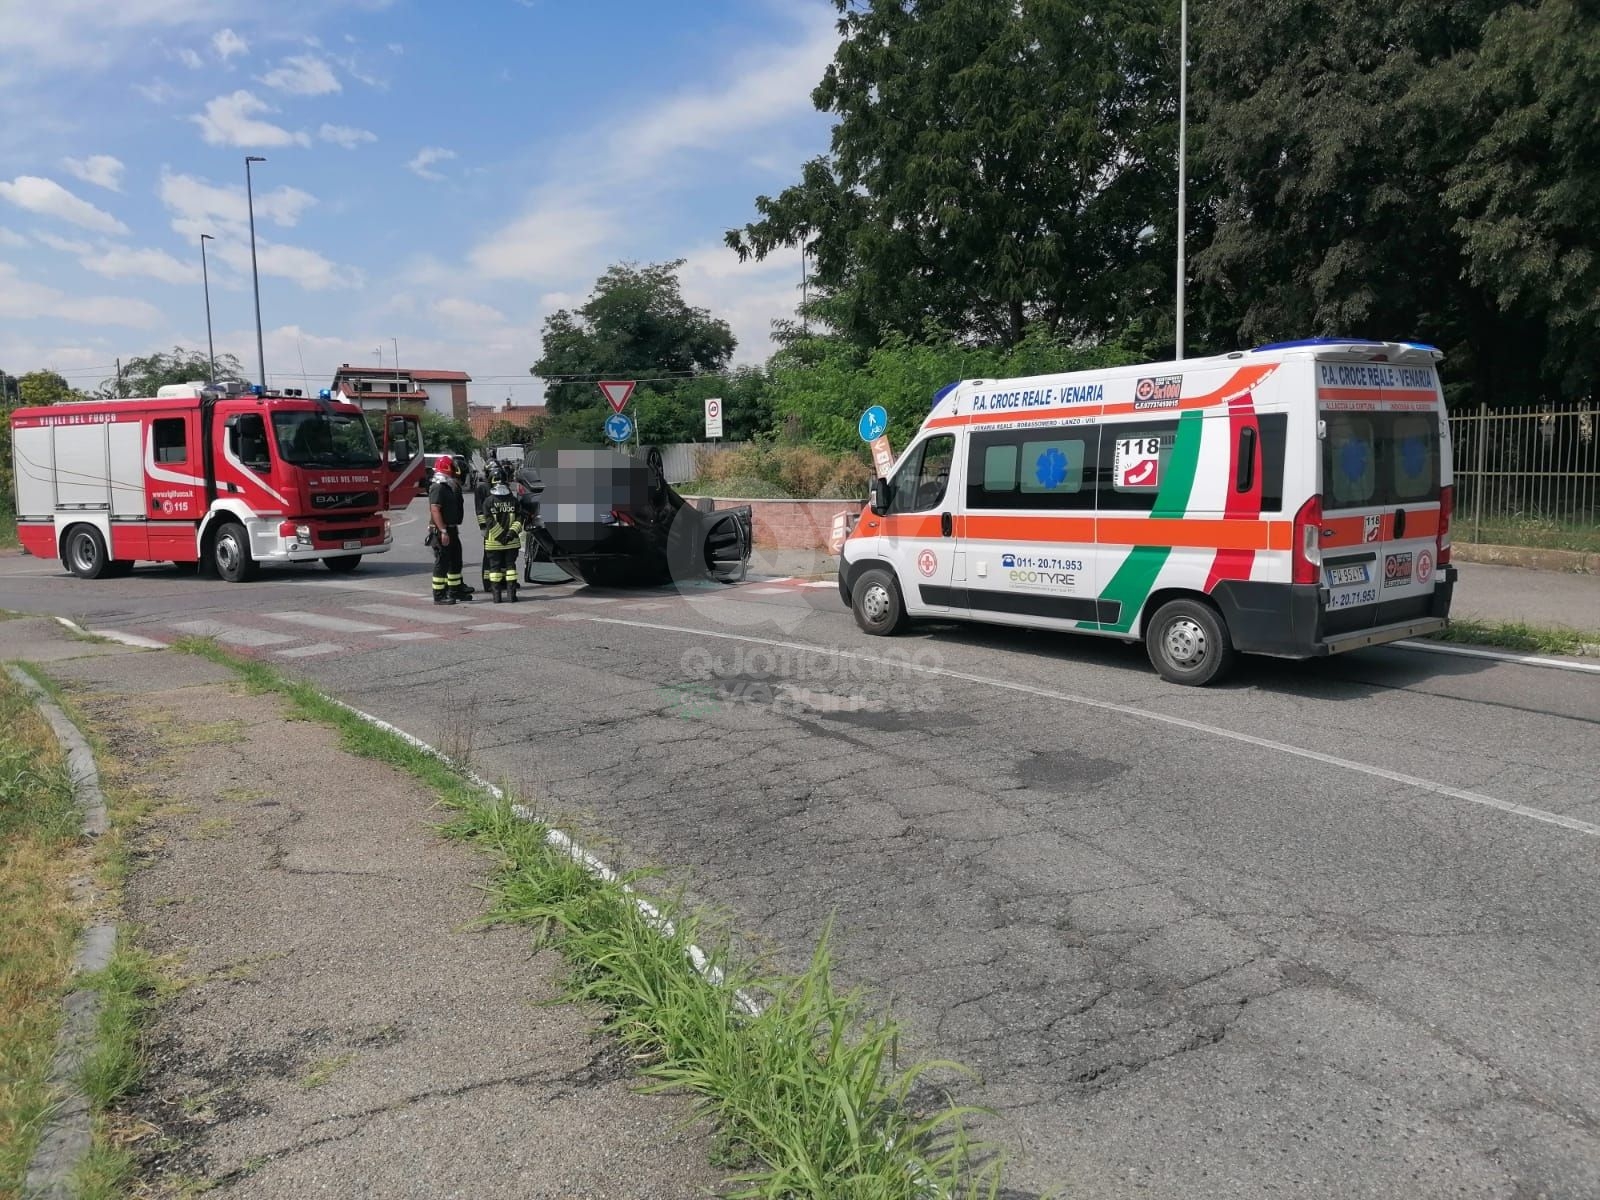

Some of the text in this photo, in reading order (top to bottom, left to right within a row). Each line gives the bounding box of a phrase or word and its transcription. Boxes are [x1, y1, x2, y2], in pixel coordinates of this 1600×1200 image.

[1321, 366, 1338, 385] P.A.
[1339, 366, 1366, 386] CROCE
[1367, 367, 1394, 386] REALE
[1399, 369, 1432, 388] VENARIA
[973, 395, 987, 410] P.A.
[990, 392, 1020, 409] CROCE
[1022, 389, 1052, 407] REALE
[1060, 384, 1103, 403] VENARIA
[40, 413, 117, 426] VIGILI DEL FUOCO
[1121, 438, 1159, 455] 118
[175, 502, 188, 511] 115
[1366, 516, 1379, 526] 118
[1038, 558, 1082, 571] 20.71.953
